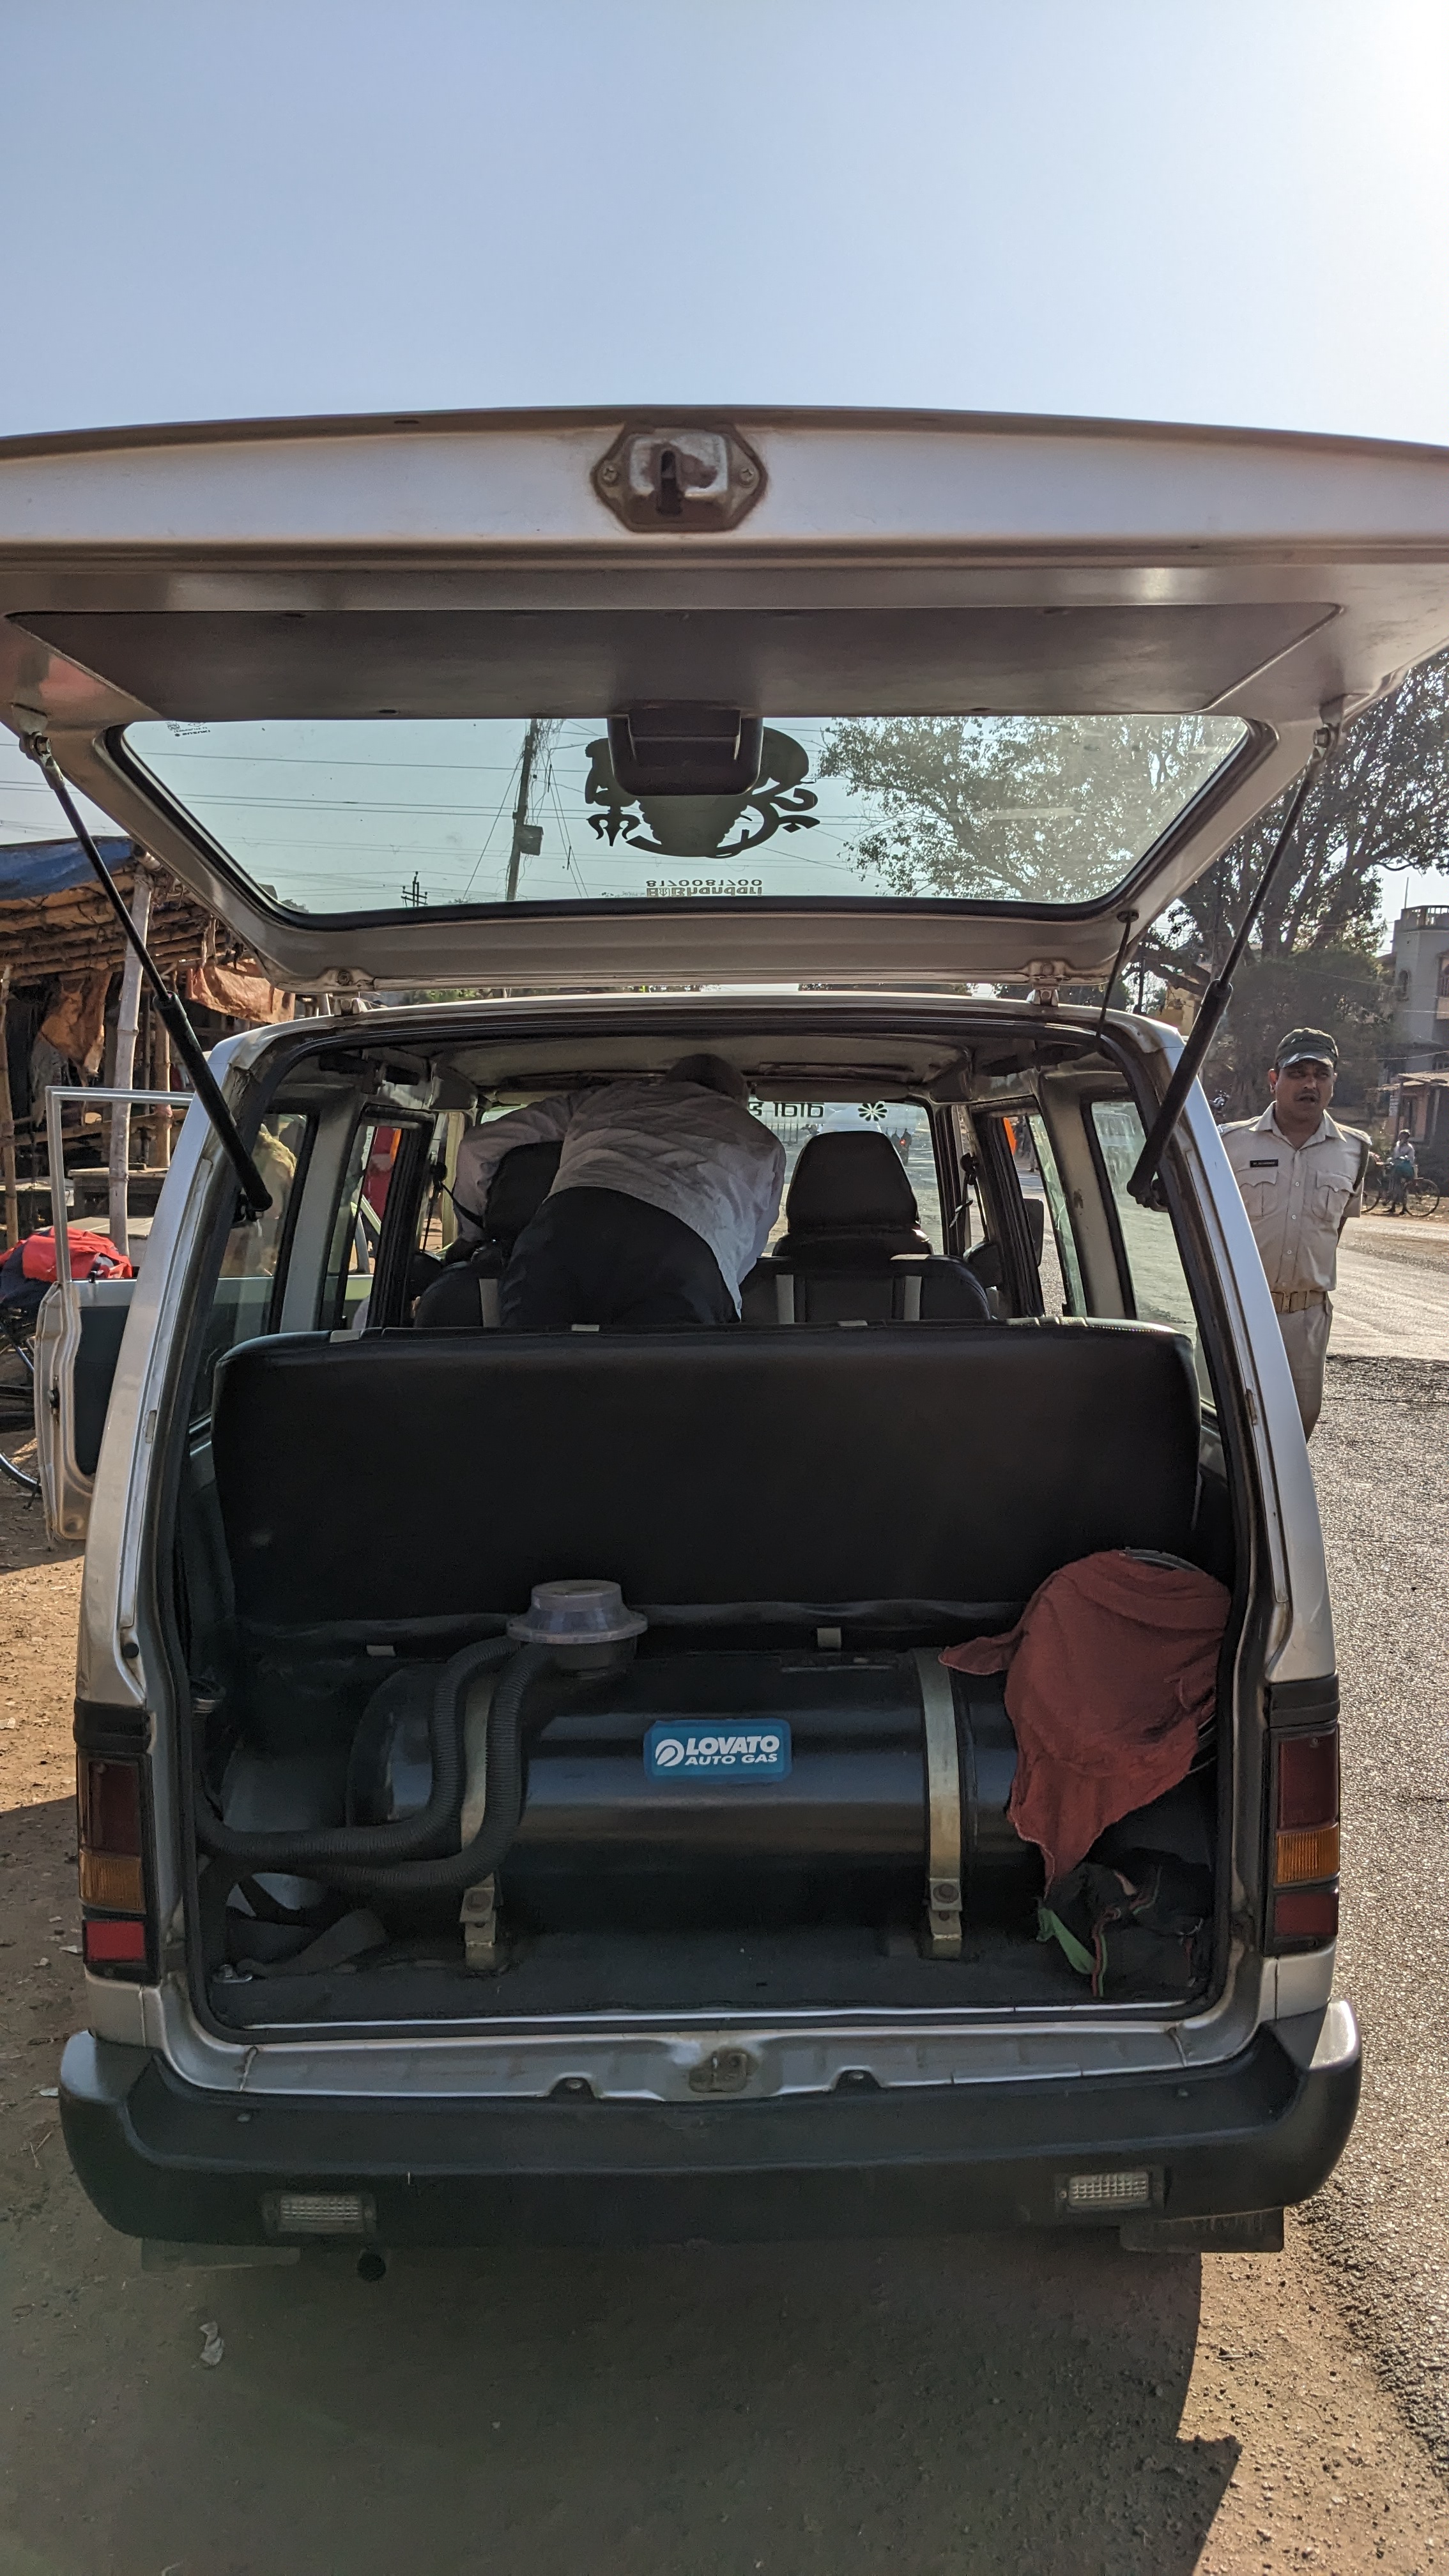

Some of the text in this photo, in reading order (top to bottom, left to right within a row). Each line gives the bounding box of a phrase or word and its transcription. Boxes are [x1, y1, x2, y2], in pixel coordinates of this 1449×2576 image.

[686, 1735, 780, 1755] LOVATO
[684, 1753, 778, 1766] AUTO GAS
